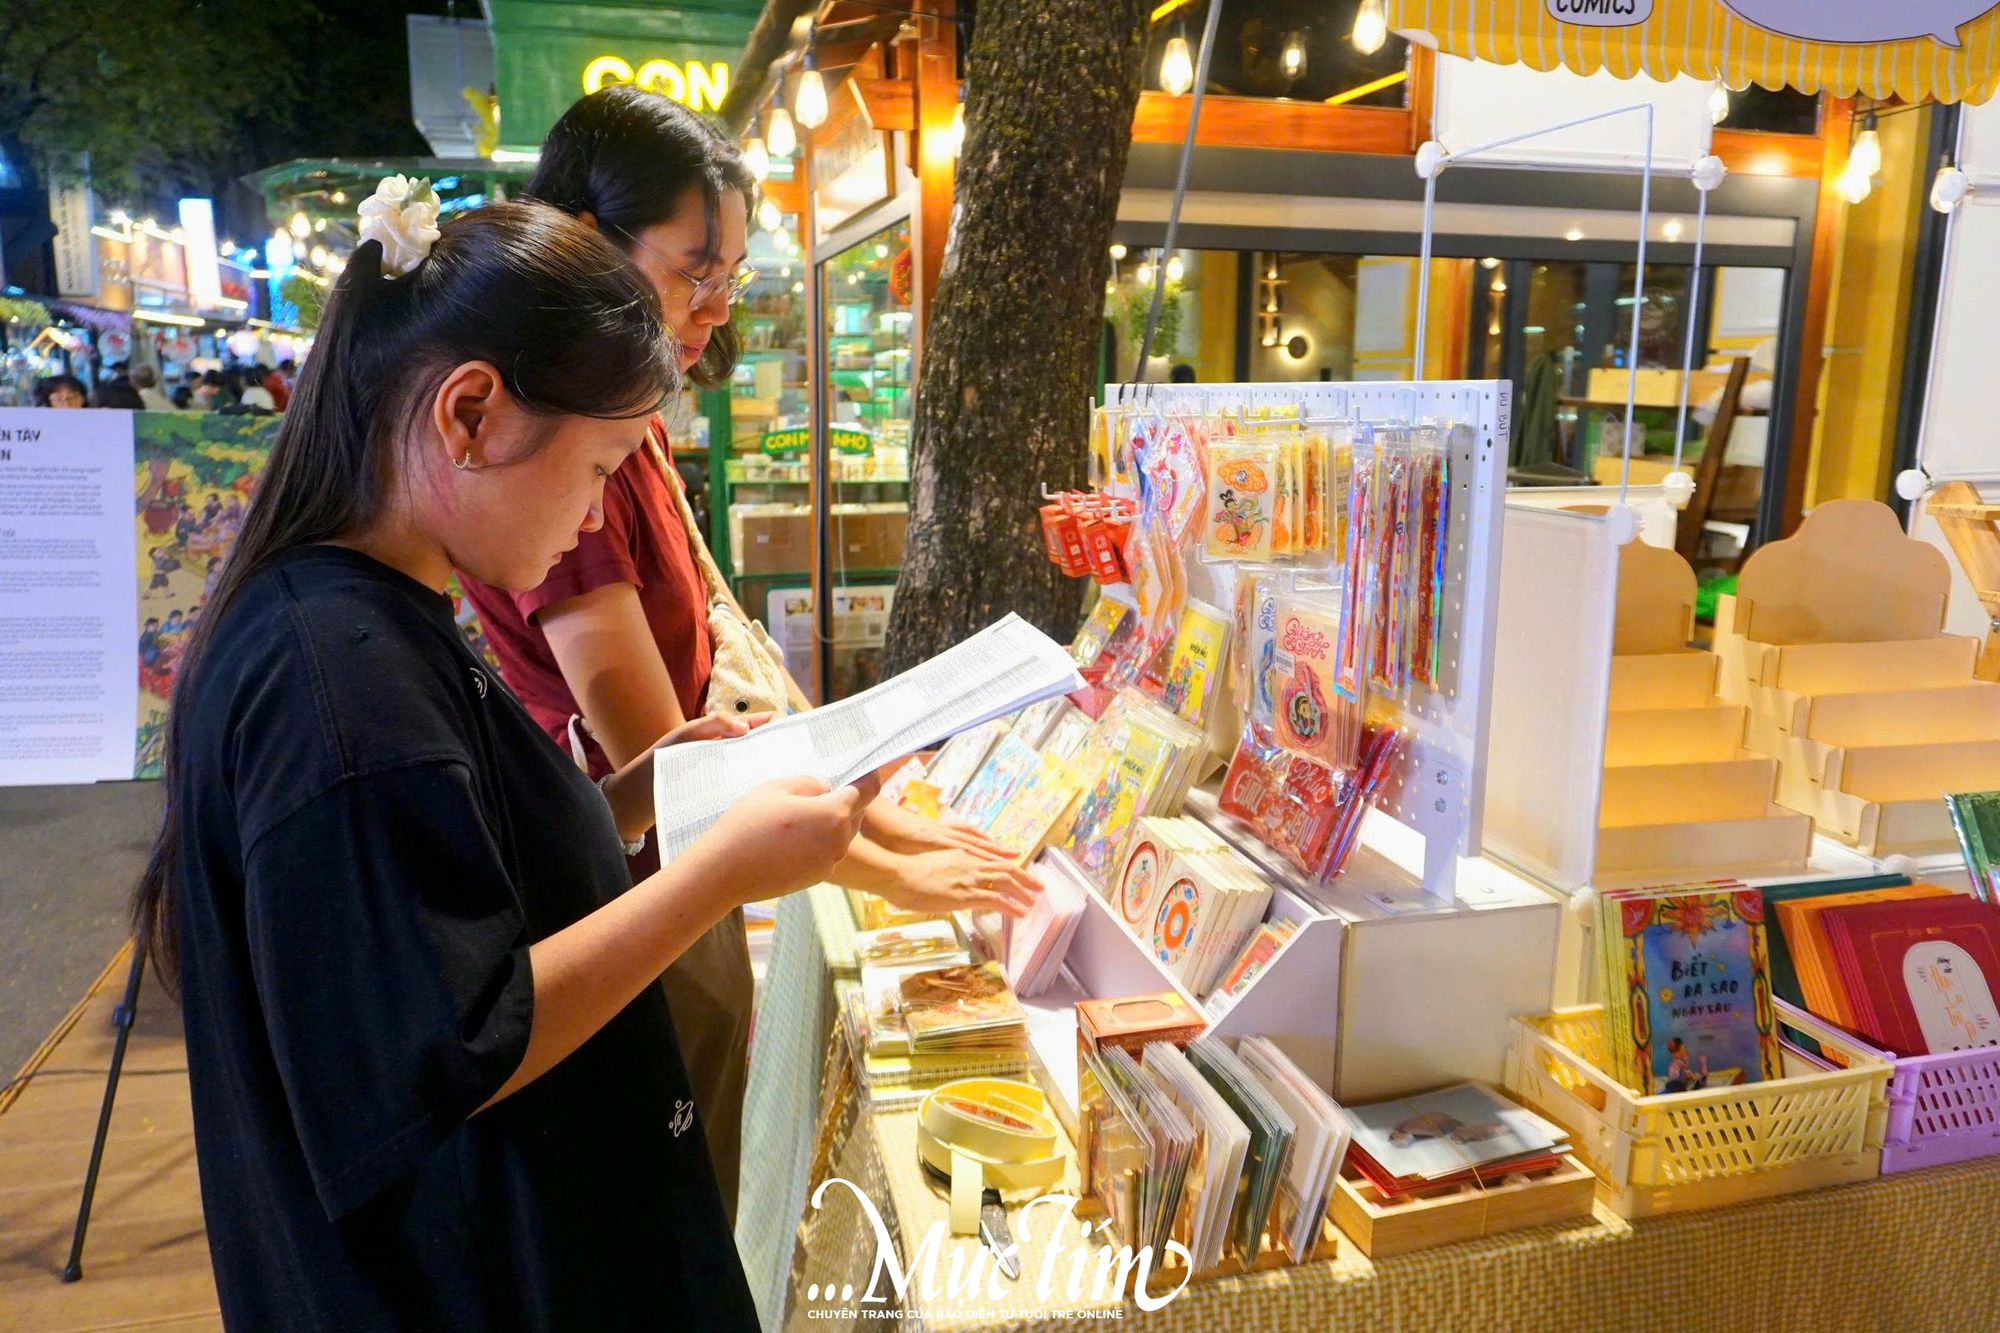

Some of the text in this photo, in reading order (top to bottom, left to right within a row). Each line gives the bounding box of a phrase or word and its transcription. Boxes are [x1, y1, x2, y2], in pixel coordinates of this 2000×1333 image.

[582, 55, 729, 112] CON
[1684, 980, 1739, 998] RA SAO
[1672, 1001, 1731, 1018] NGÀY SAU
